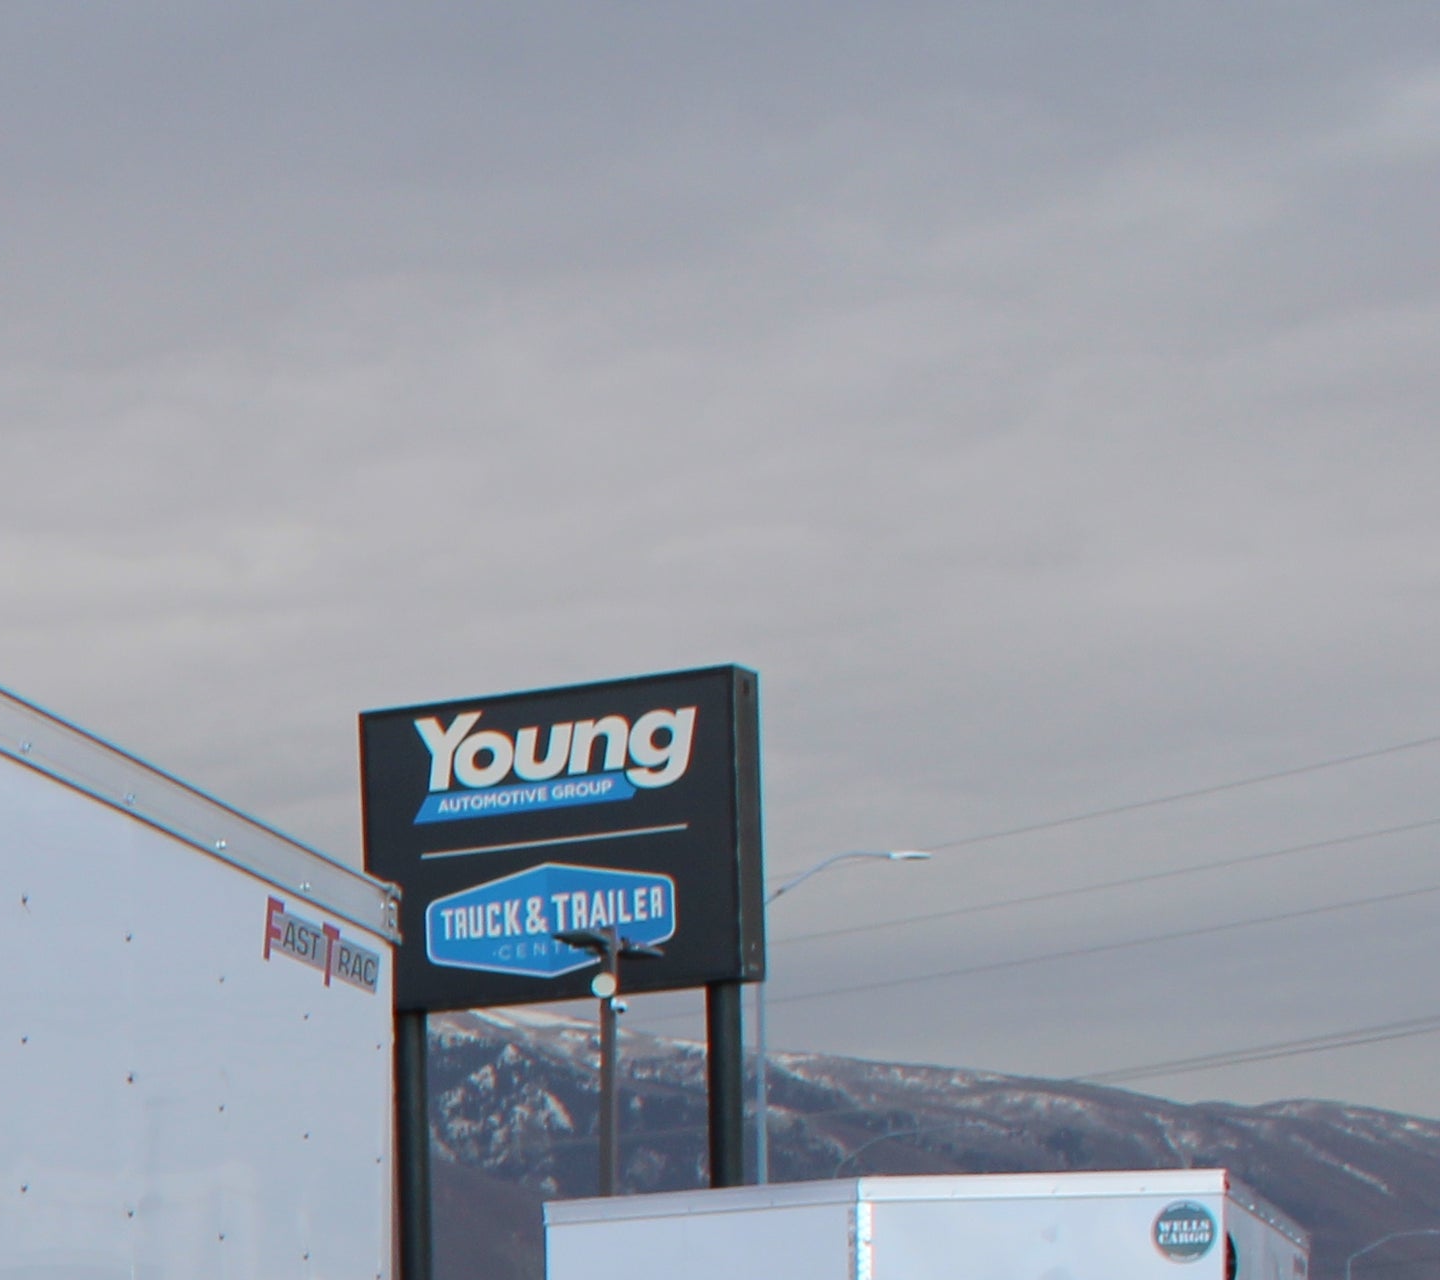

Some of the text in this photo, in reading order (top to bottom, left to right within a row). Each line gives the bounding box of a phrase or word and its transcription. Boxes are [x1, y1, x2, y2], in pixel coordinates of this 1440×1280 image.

[413, 706, 698, 792] Young
[437, 780, 614, 814] AUTOMOTIVE GROUP
[440, 886, 664, 940] TRUCK & TRAILER
